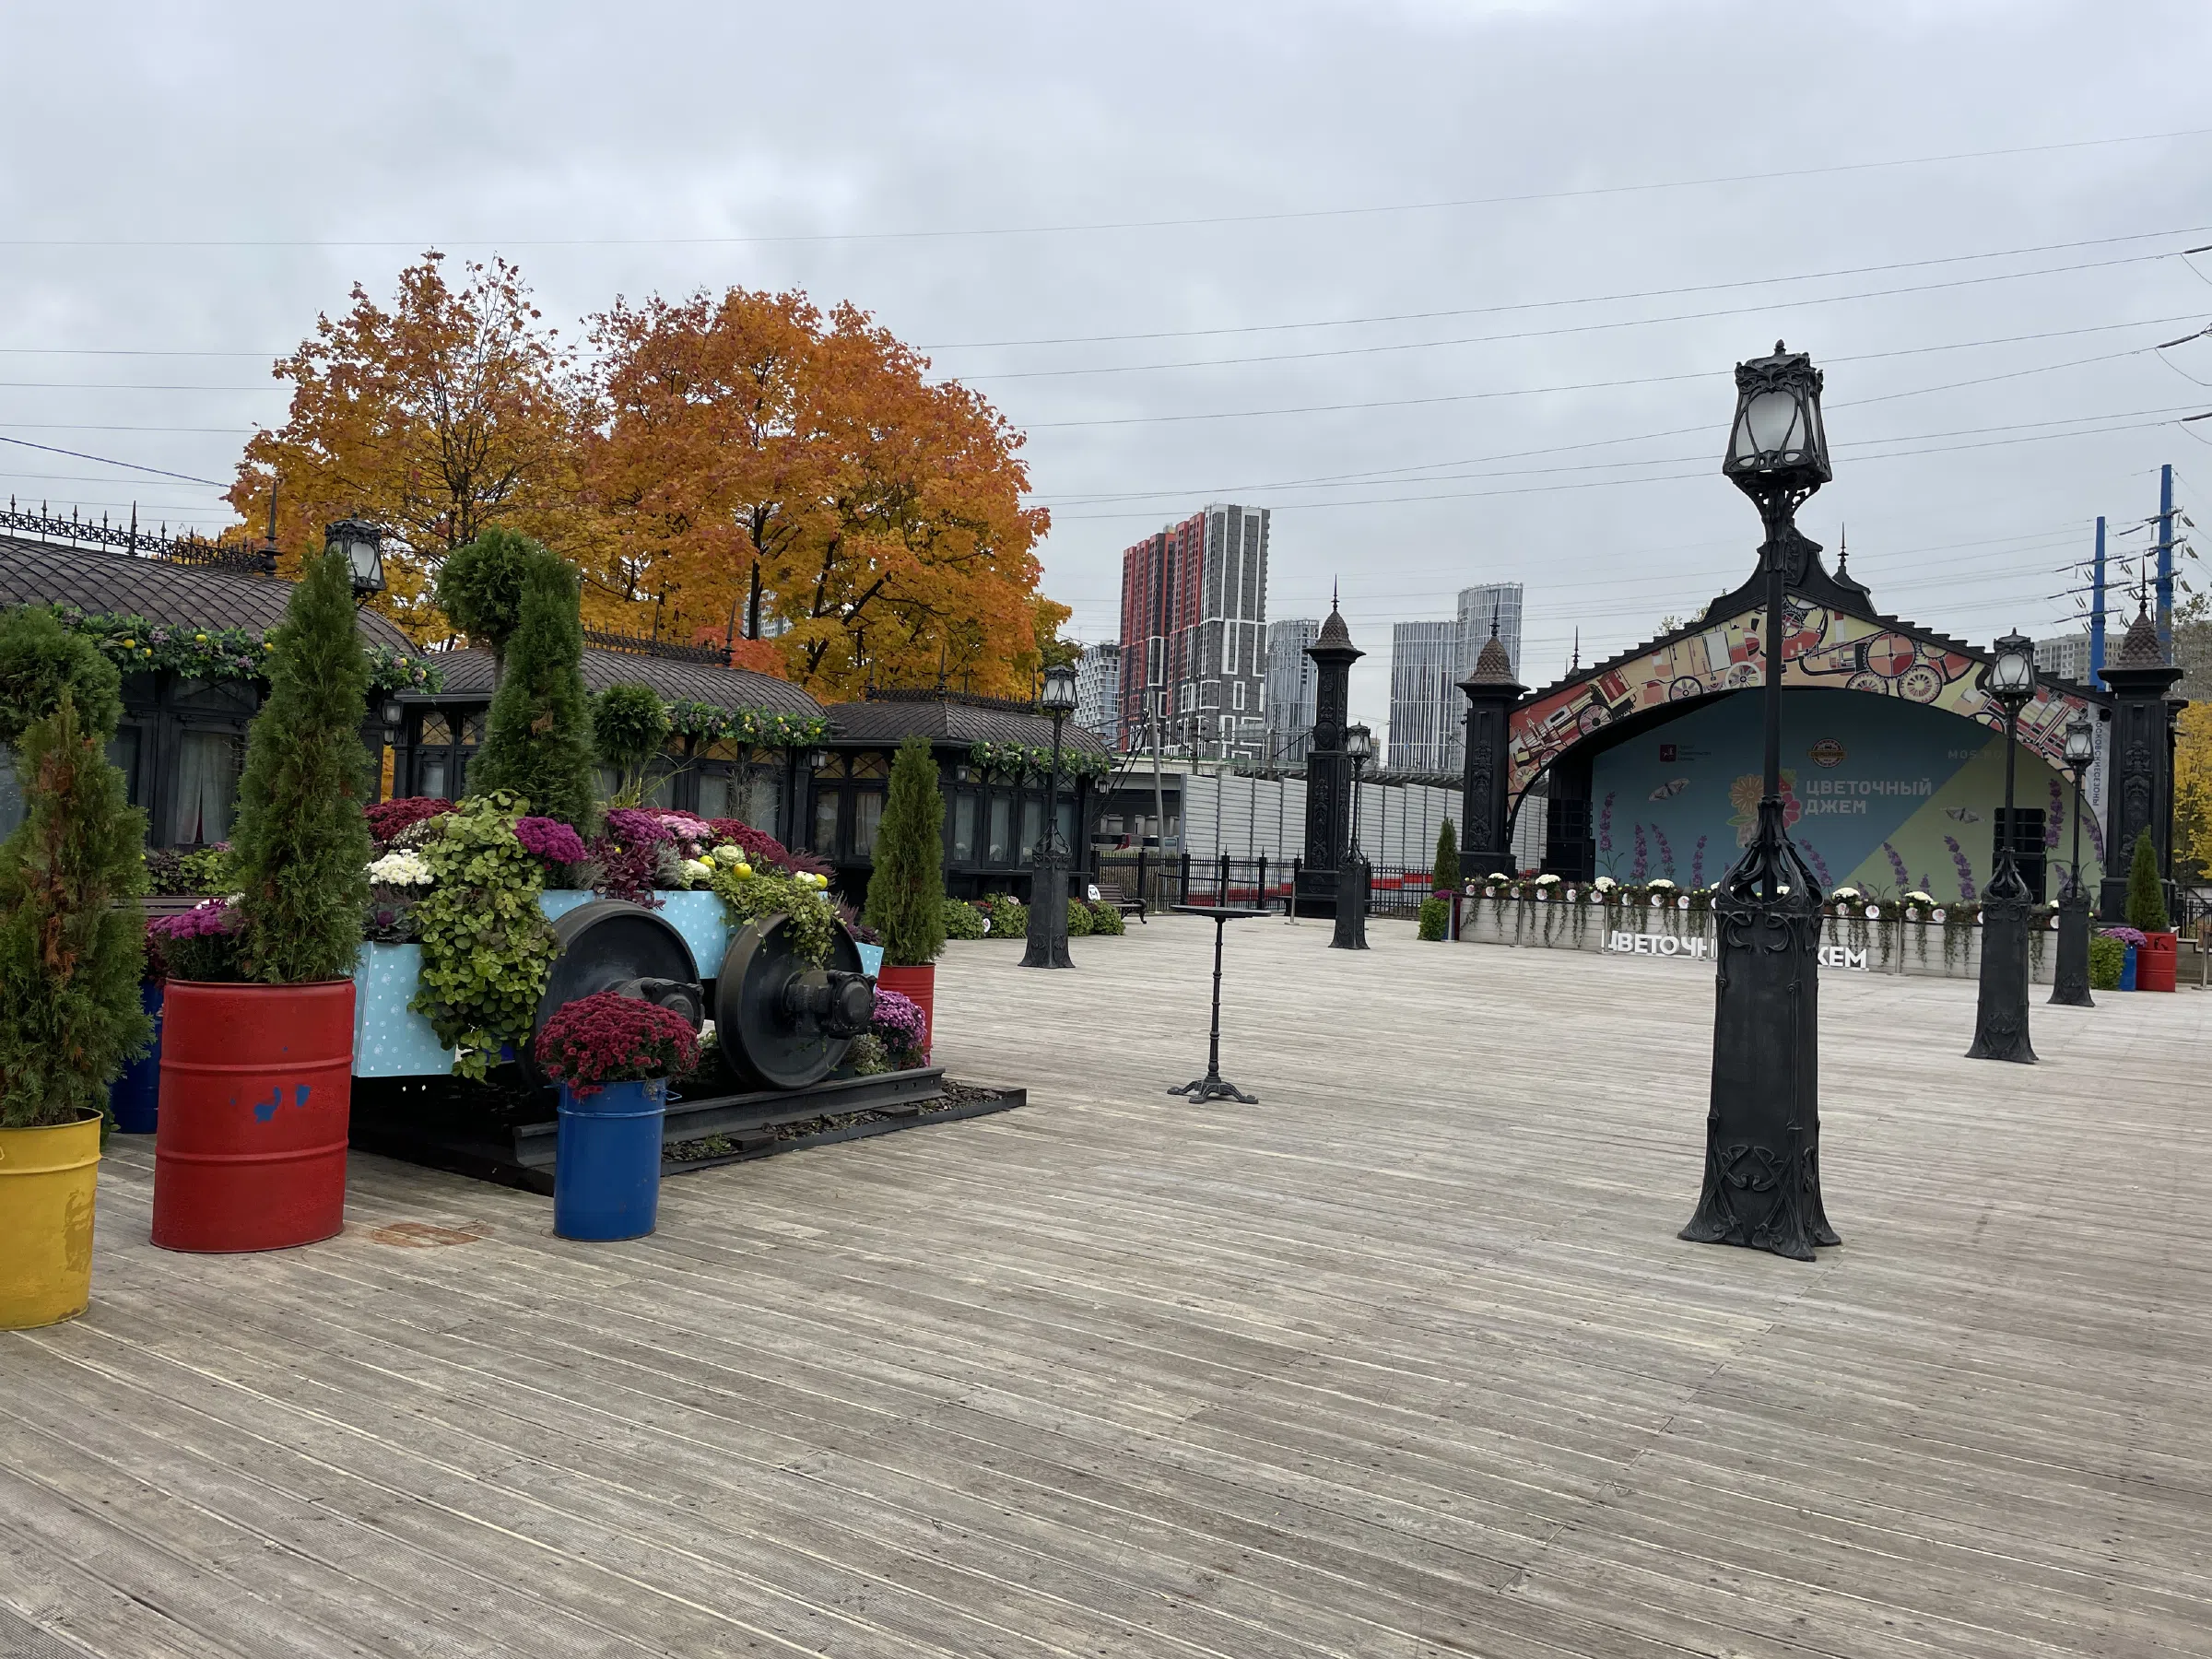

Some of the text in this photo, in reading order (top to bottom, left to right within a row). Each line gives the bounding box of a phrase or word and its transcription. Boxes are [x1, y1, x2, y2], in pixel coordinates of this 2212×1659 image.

[2093, 712, 2102, 806] ОСКОВСКИЕСЕЗОНЫ
[1806, 778, 1933, 796] ЦВЕТОЧНЫЙ
[1804, 799, 1866, 816] ДЖЕМ
[1601, 929, 1718, 958] ЦВЕТОЧН
